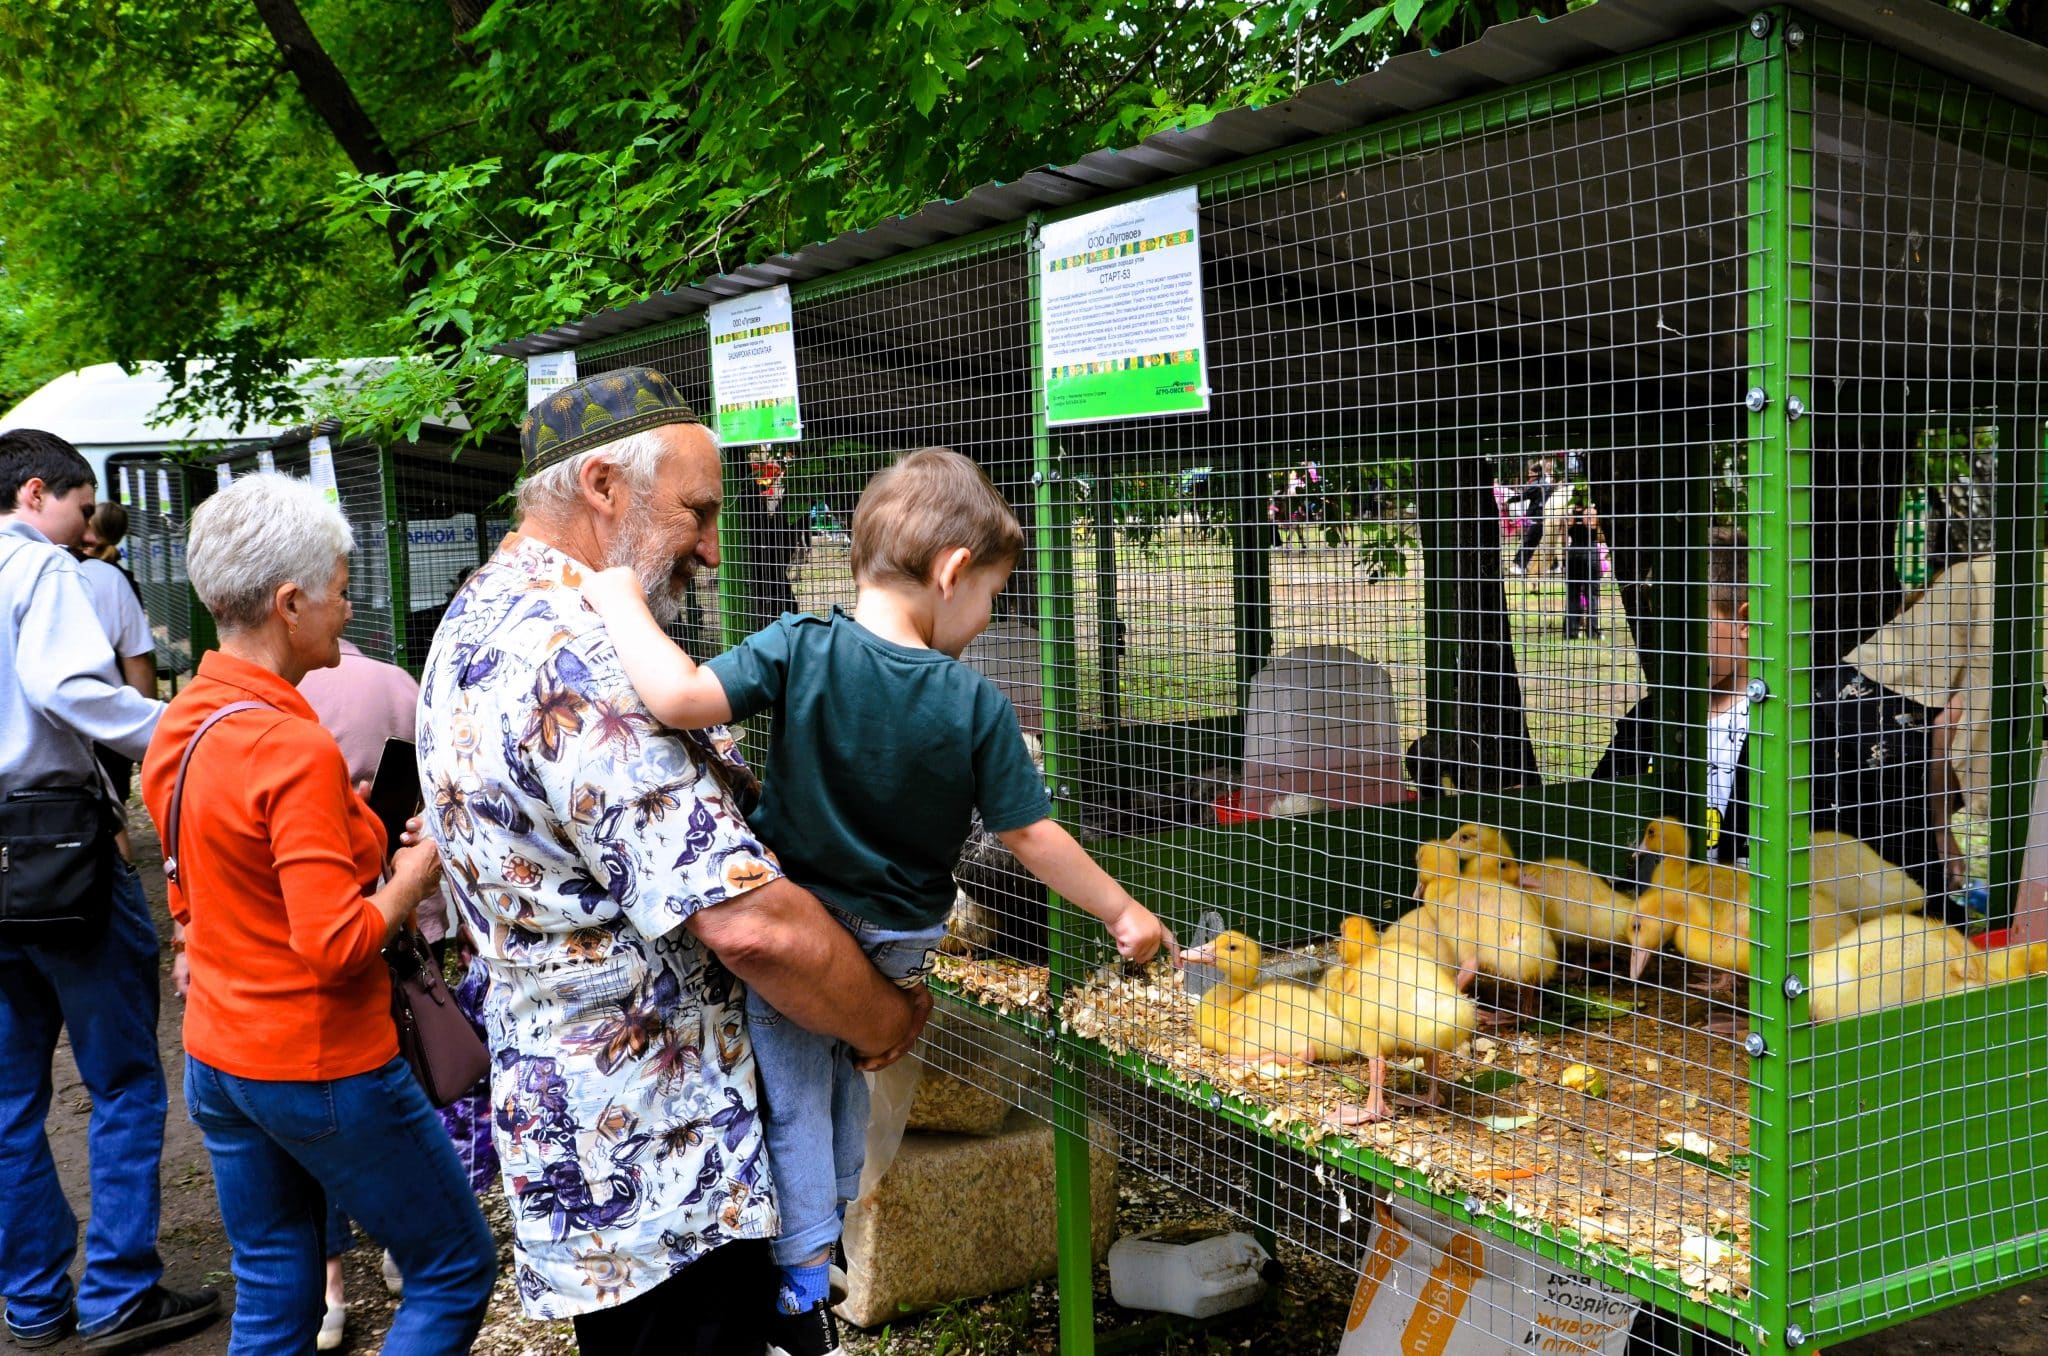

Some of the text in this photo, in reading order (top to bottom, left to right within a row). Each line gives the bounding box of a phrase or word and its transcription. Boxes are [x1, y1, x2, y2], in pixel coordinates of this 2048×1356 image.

[1087, 235, 1105, 249] ООО
[1099, 268, 1131, 284] СТАРТ-53
[1523, 1330, 1542, 1347] И
